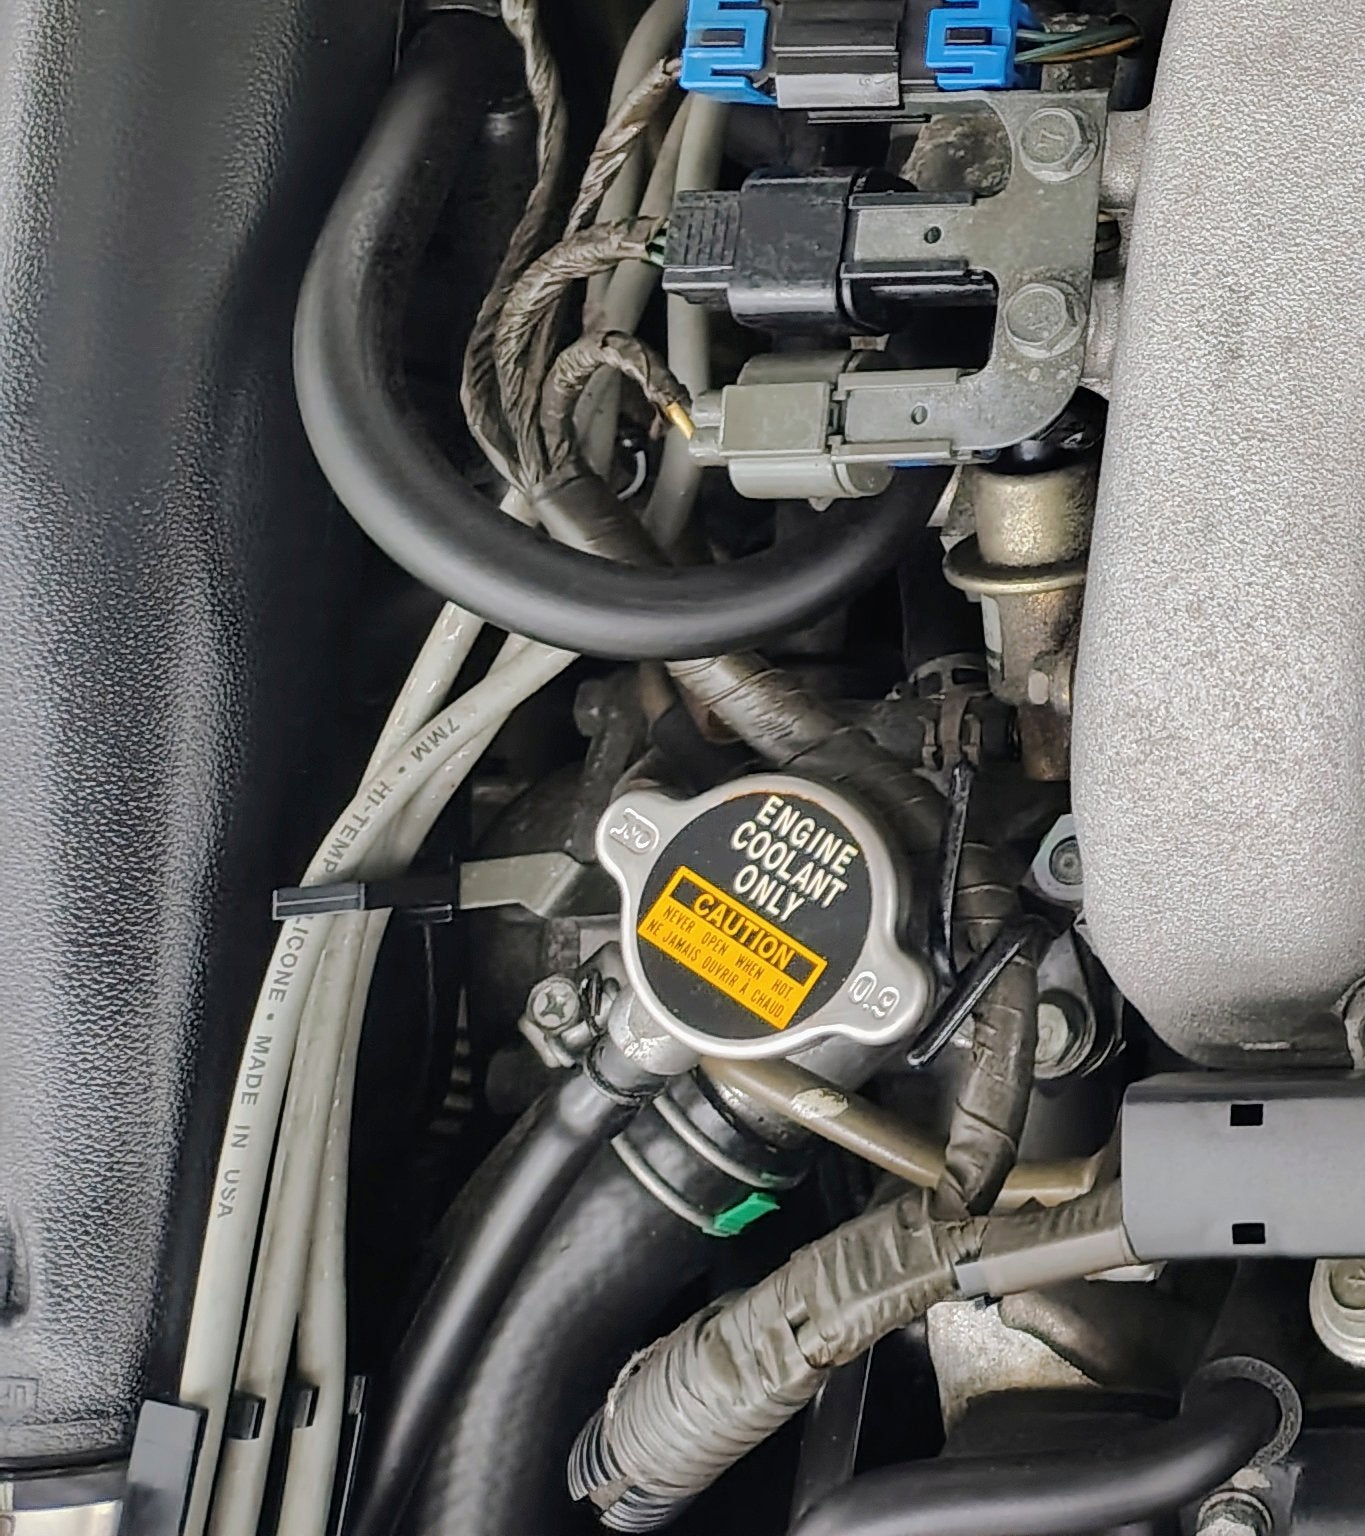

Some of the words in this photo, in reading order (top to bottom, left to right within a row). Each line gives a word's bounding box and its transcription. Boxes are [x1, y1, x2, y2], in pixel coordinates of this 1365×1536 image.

[410, 717, 461, 763] 7MM
[323, 779, 394, 875] HI-TEMP
[755, 795, 859, 877] ENGINE
[730, 820, 849, 910] COOLANT
[733, 864, 806, 923] ONLY
[645, 918, 661, 937] NE
[662, 927, 702, 962] JAMAIS
[701, 952, 739, 989] OUVRIR
[663, 905, 696, 936] NEVER
[700, 926, 729, 956] OPEN
[734, 947, 764, 981] WHEN
[692, 892, 796, 972] CAUTION
[849, 970, 900, 1018] 0.9
[240, 1034, 273, 1107] MADE
[229, 1124, 251, 1149] IN
[216, 1168, 241, 1220] USA
